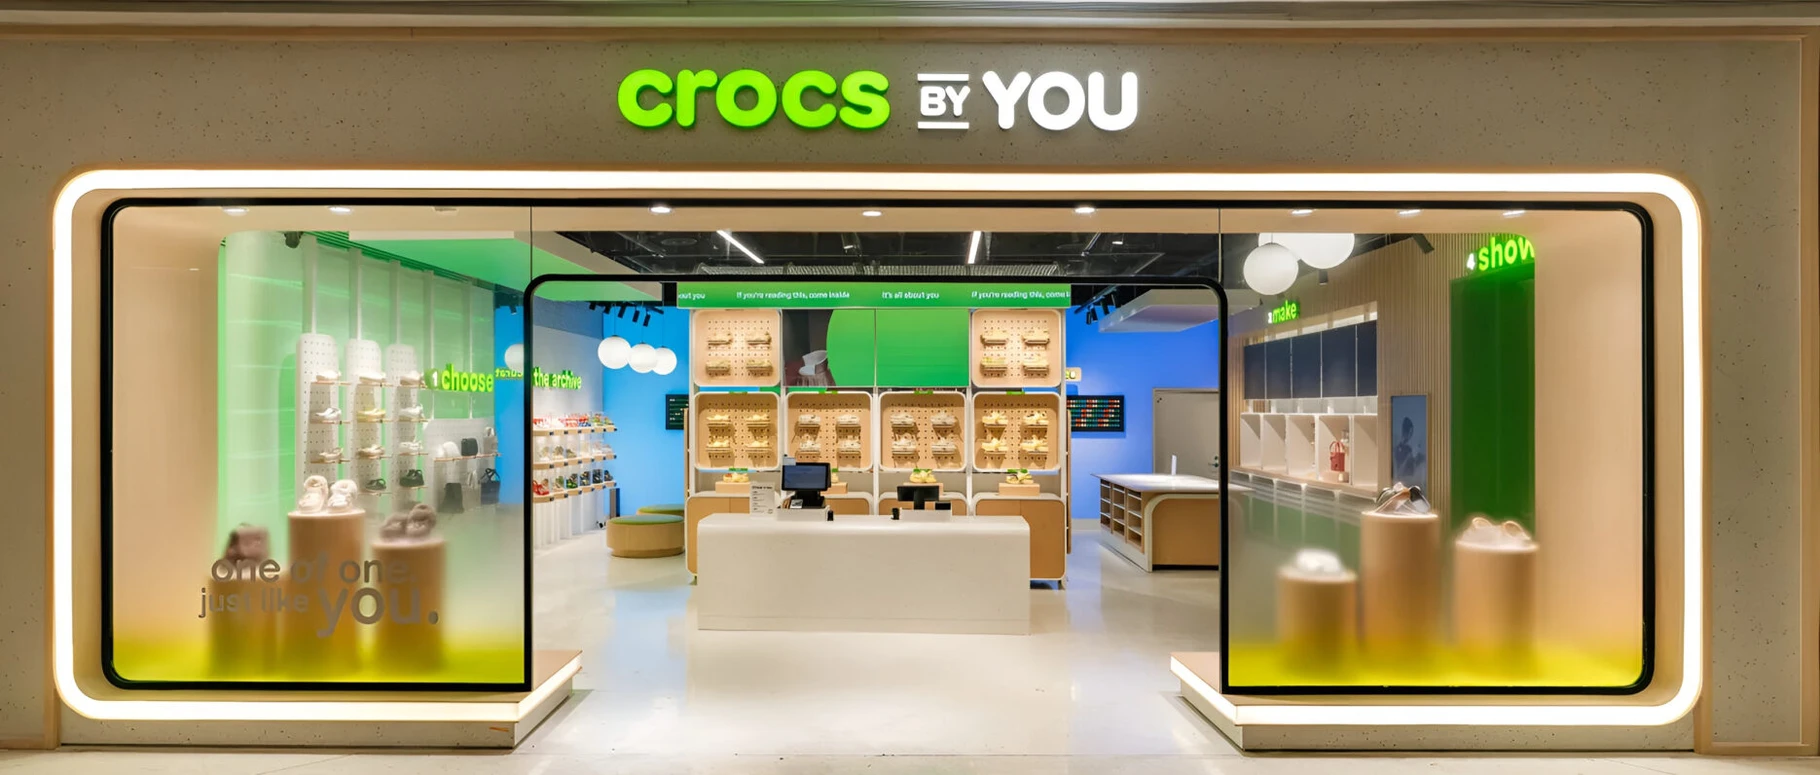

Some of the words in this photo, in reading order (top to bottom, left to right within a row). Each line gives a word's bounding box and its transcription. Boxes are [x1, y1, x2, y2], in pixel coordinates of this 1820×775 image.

[617, 68, 891, 131] crocs
[920, 86, 971, 117] BY
[982, 70, 1138, 131] YOU
[1478, 236, 1535, 271] show
[1272, 299, 1298, 324] make
[431, 371, 438, 387] 1
[441, 364, 494, 392] choose
[533, 367, 549, 387] the
[552, 370, 582, 390] archive
[211, 559, 281, 583] one
[290, 551, 330, 583] of
[198, 587, 251, 618] just
[261, 587, 309, 613] like
[316, 587, 439, 639] you.
